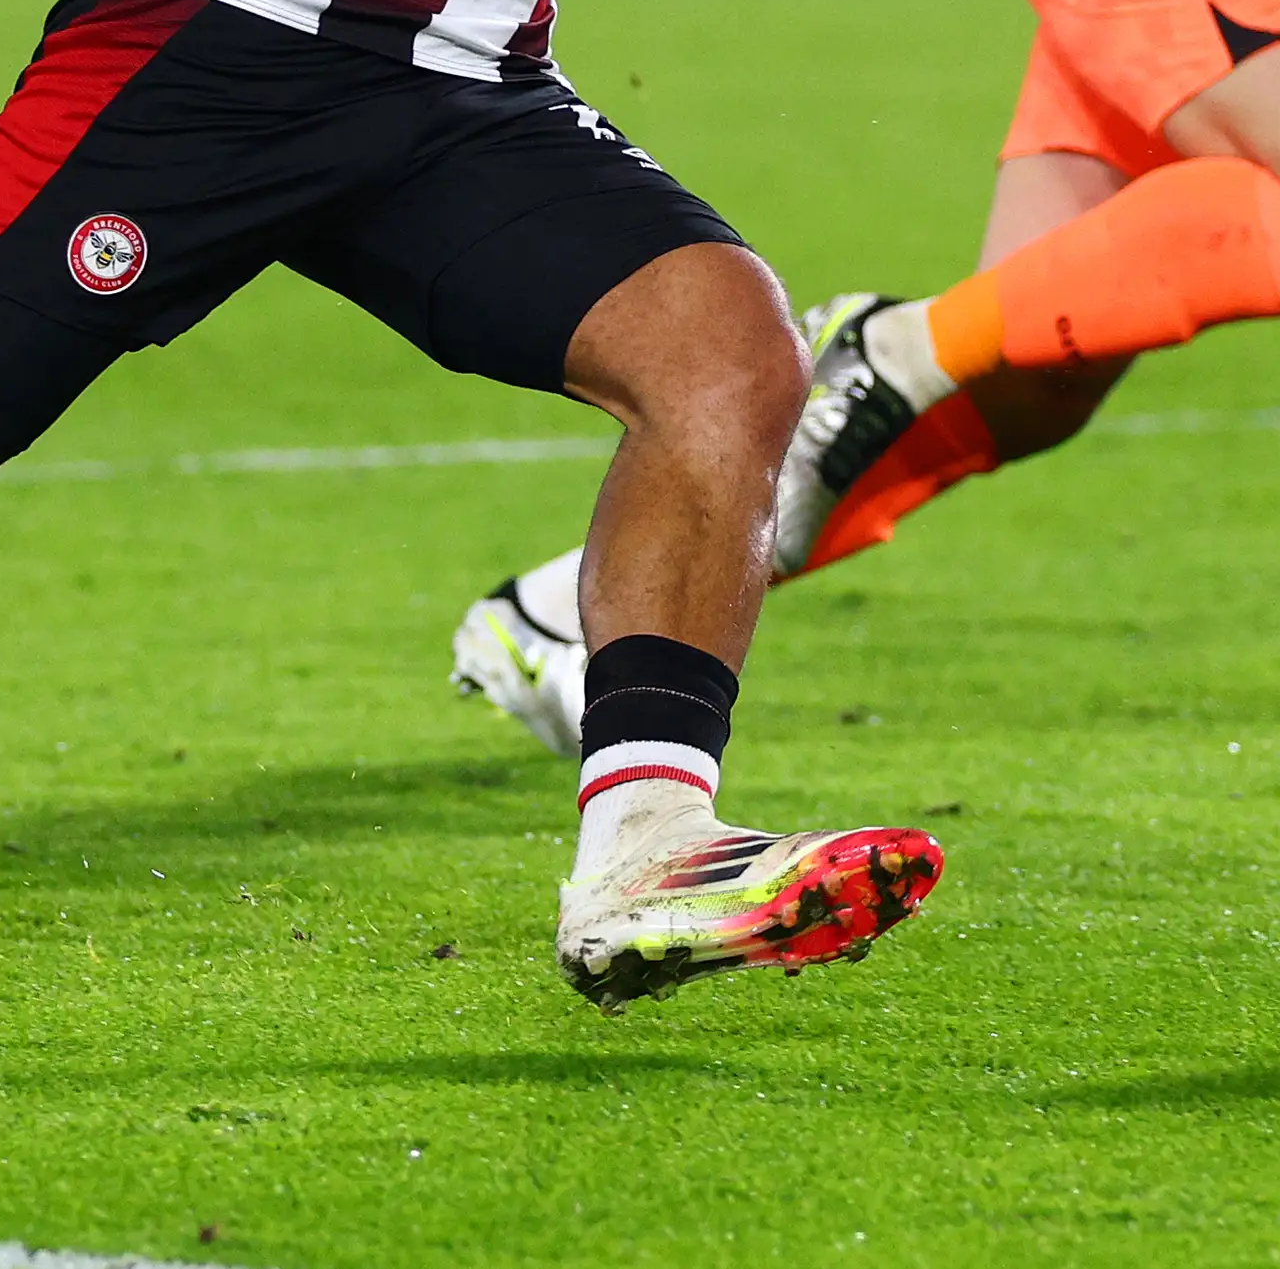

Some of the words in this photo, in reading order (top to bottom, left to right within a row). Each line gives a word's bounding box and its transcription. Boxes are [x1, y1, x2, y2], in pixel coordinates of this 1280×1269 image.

[92, 220, 142, 252] BRENTFORD
[73, 254, 99, 286] FOOTBALL
[101, 279, 122, 288] CLUB
